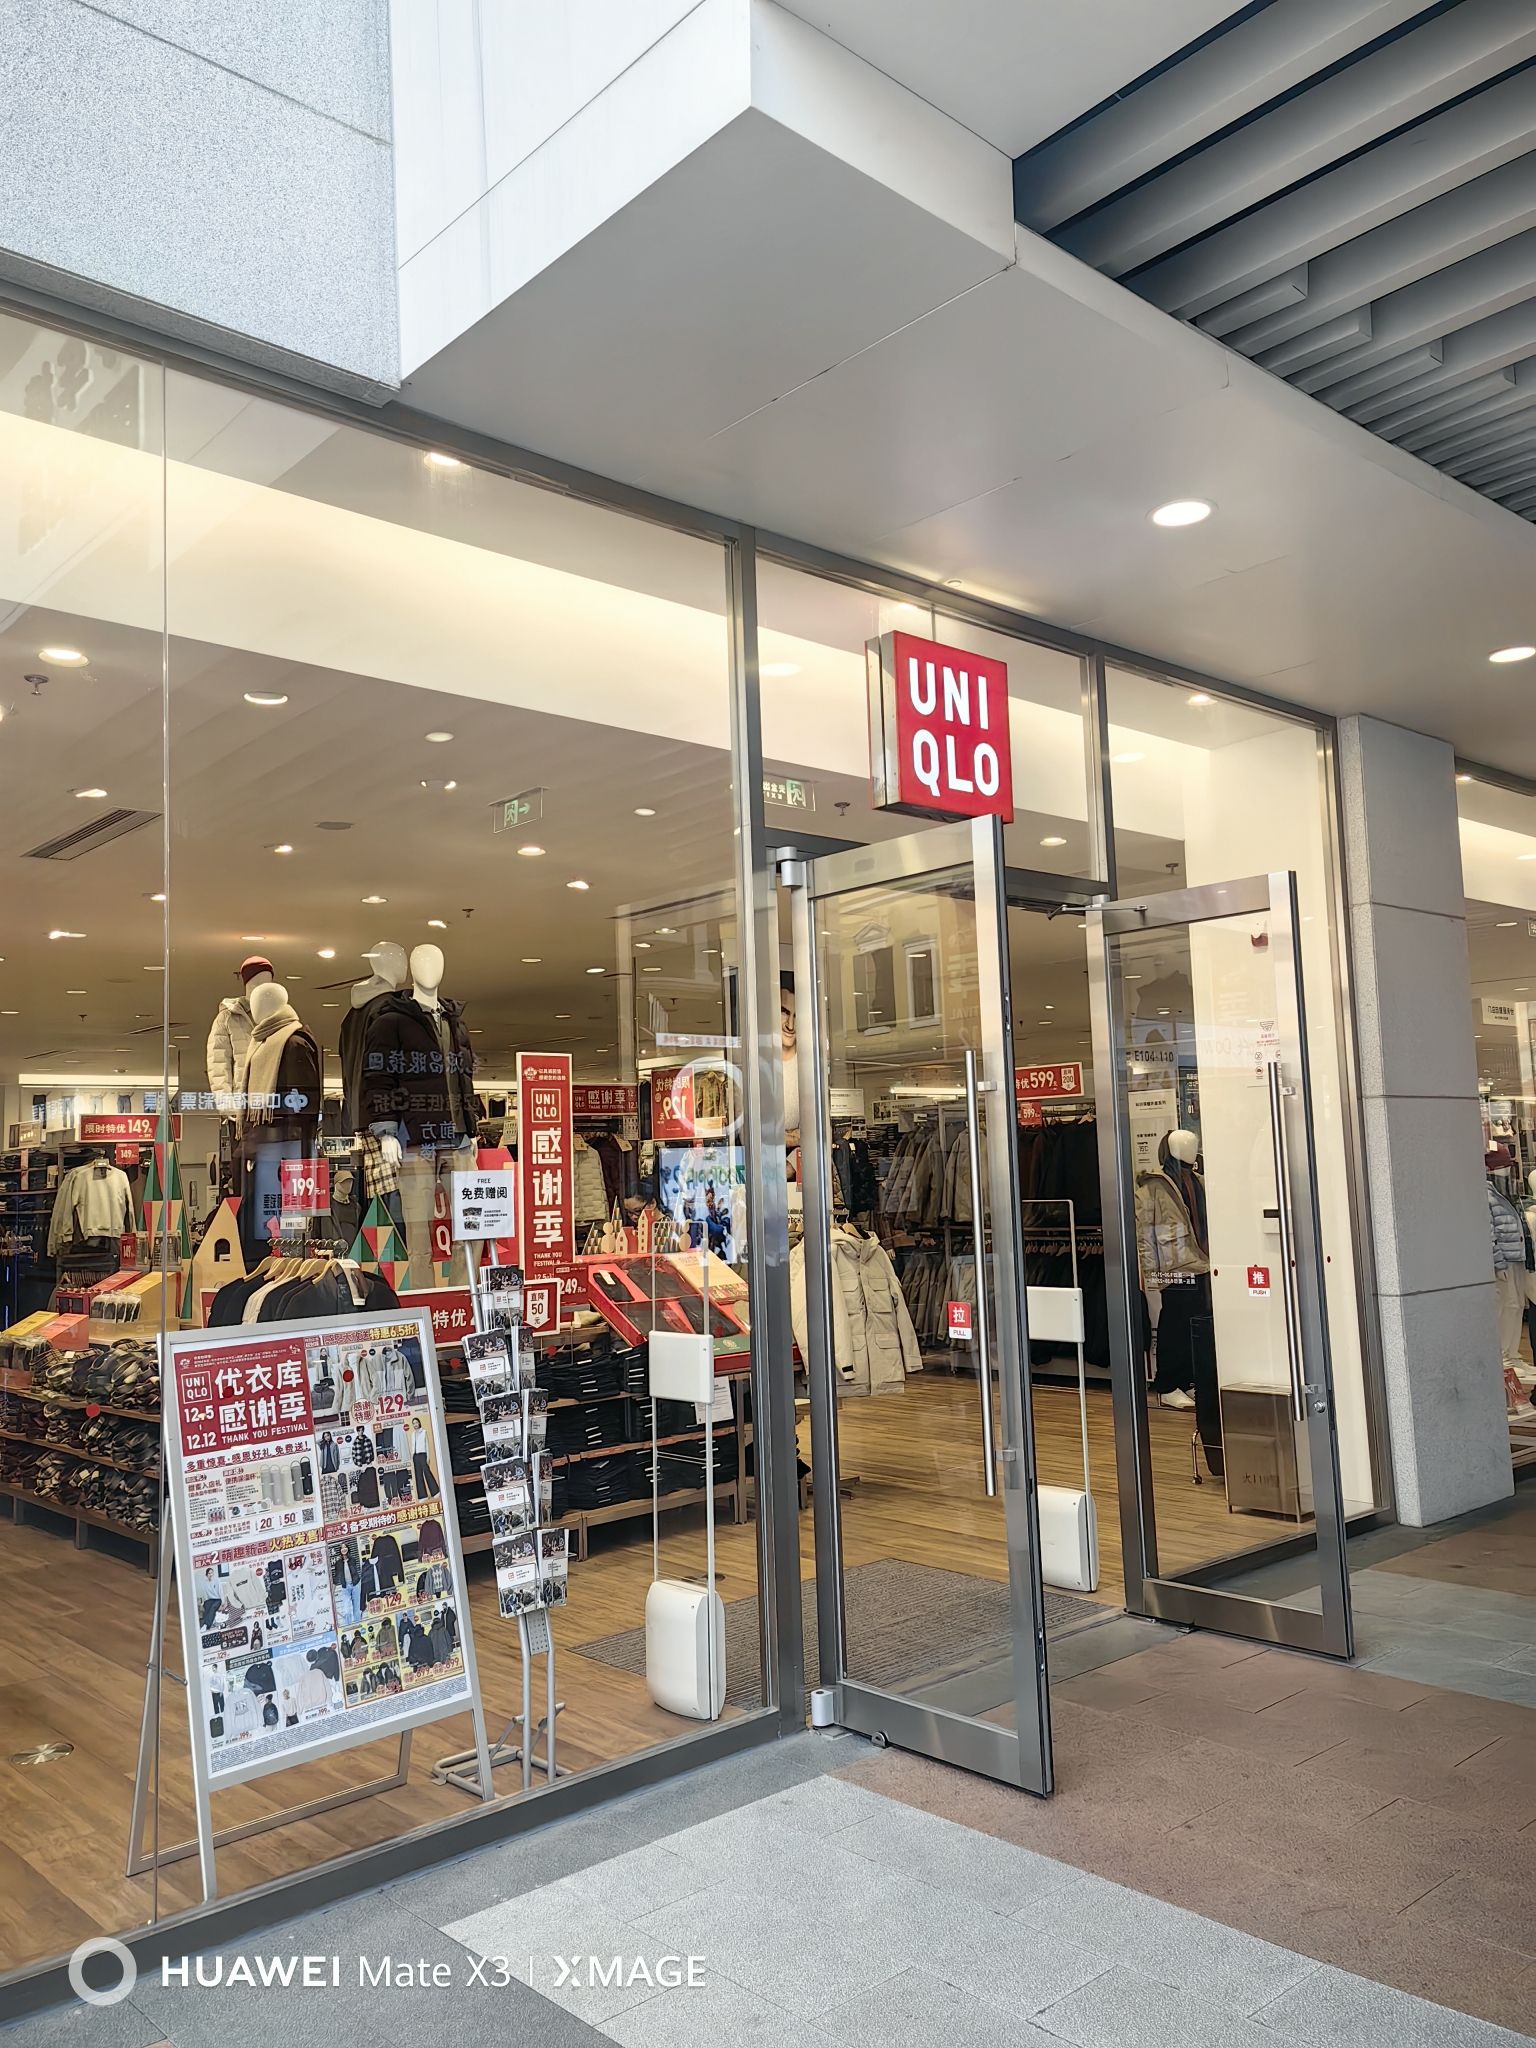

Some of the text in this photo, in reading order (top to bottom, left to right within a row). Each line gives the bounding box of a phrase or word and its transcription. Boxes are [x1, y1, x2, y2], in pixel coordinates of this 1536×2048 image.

[909, 657, 989, 730] UNI
[912, 729, 1000, 797] QLO
[1030, 1070, 1055, 1089] 599
[535, 1093, 556, 1105] UNI
[588, 1089, 626, 1105] 感谢季
[535, 1106, 557, 1119] QLO
[1023, 1108, 1036, 1119] 599
[84, 1123, 127, 1134] 限时特优
[127, 1119, 150, 1134] 149
[120, 1149, 133, 1159] 149
[292, 1177, 314, 1197] 199
[461, 1186, 508, 1200] 免费赠阅
[531, 1127, 564, 1249] 感谢季
[1253, 1271, 1265, 1285] 推
[531, 1291, 545, 1301] 直降
[531, 1303, 544, 1315] 50
[953, 1306, 965, 1323] 拉
[432, 1308, 467, 1330] 特优
[534, 1317, 541, 1325] 元
[368, 1322, 420, 1341] 特惠6.5折!
[185, 1375, 206, 1388] UNI
[214, 1359, 304, 1399] 优衣库
[186, 1387, 208, 1400] QLO
[218, 1390, 307, 1434] 感谢季
[378, 1394, 404, 1415] 129
[186, 1431, 217, 1450] 12.12
[222, 1422, 309, 1445] THANK YOU FESTIVAL
[274, 1441, 309, 1456] 免费送!
[260, 1517, 272, 1529] 20
[284, 1512, 296, 1524] 50
[269, 1527, 325, 1553] 火热发售!
[384, 1592, 402, 1608] 129
